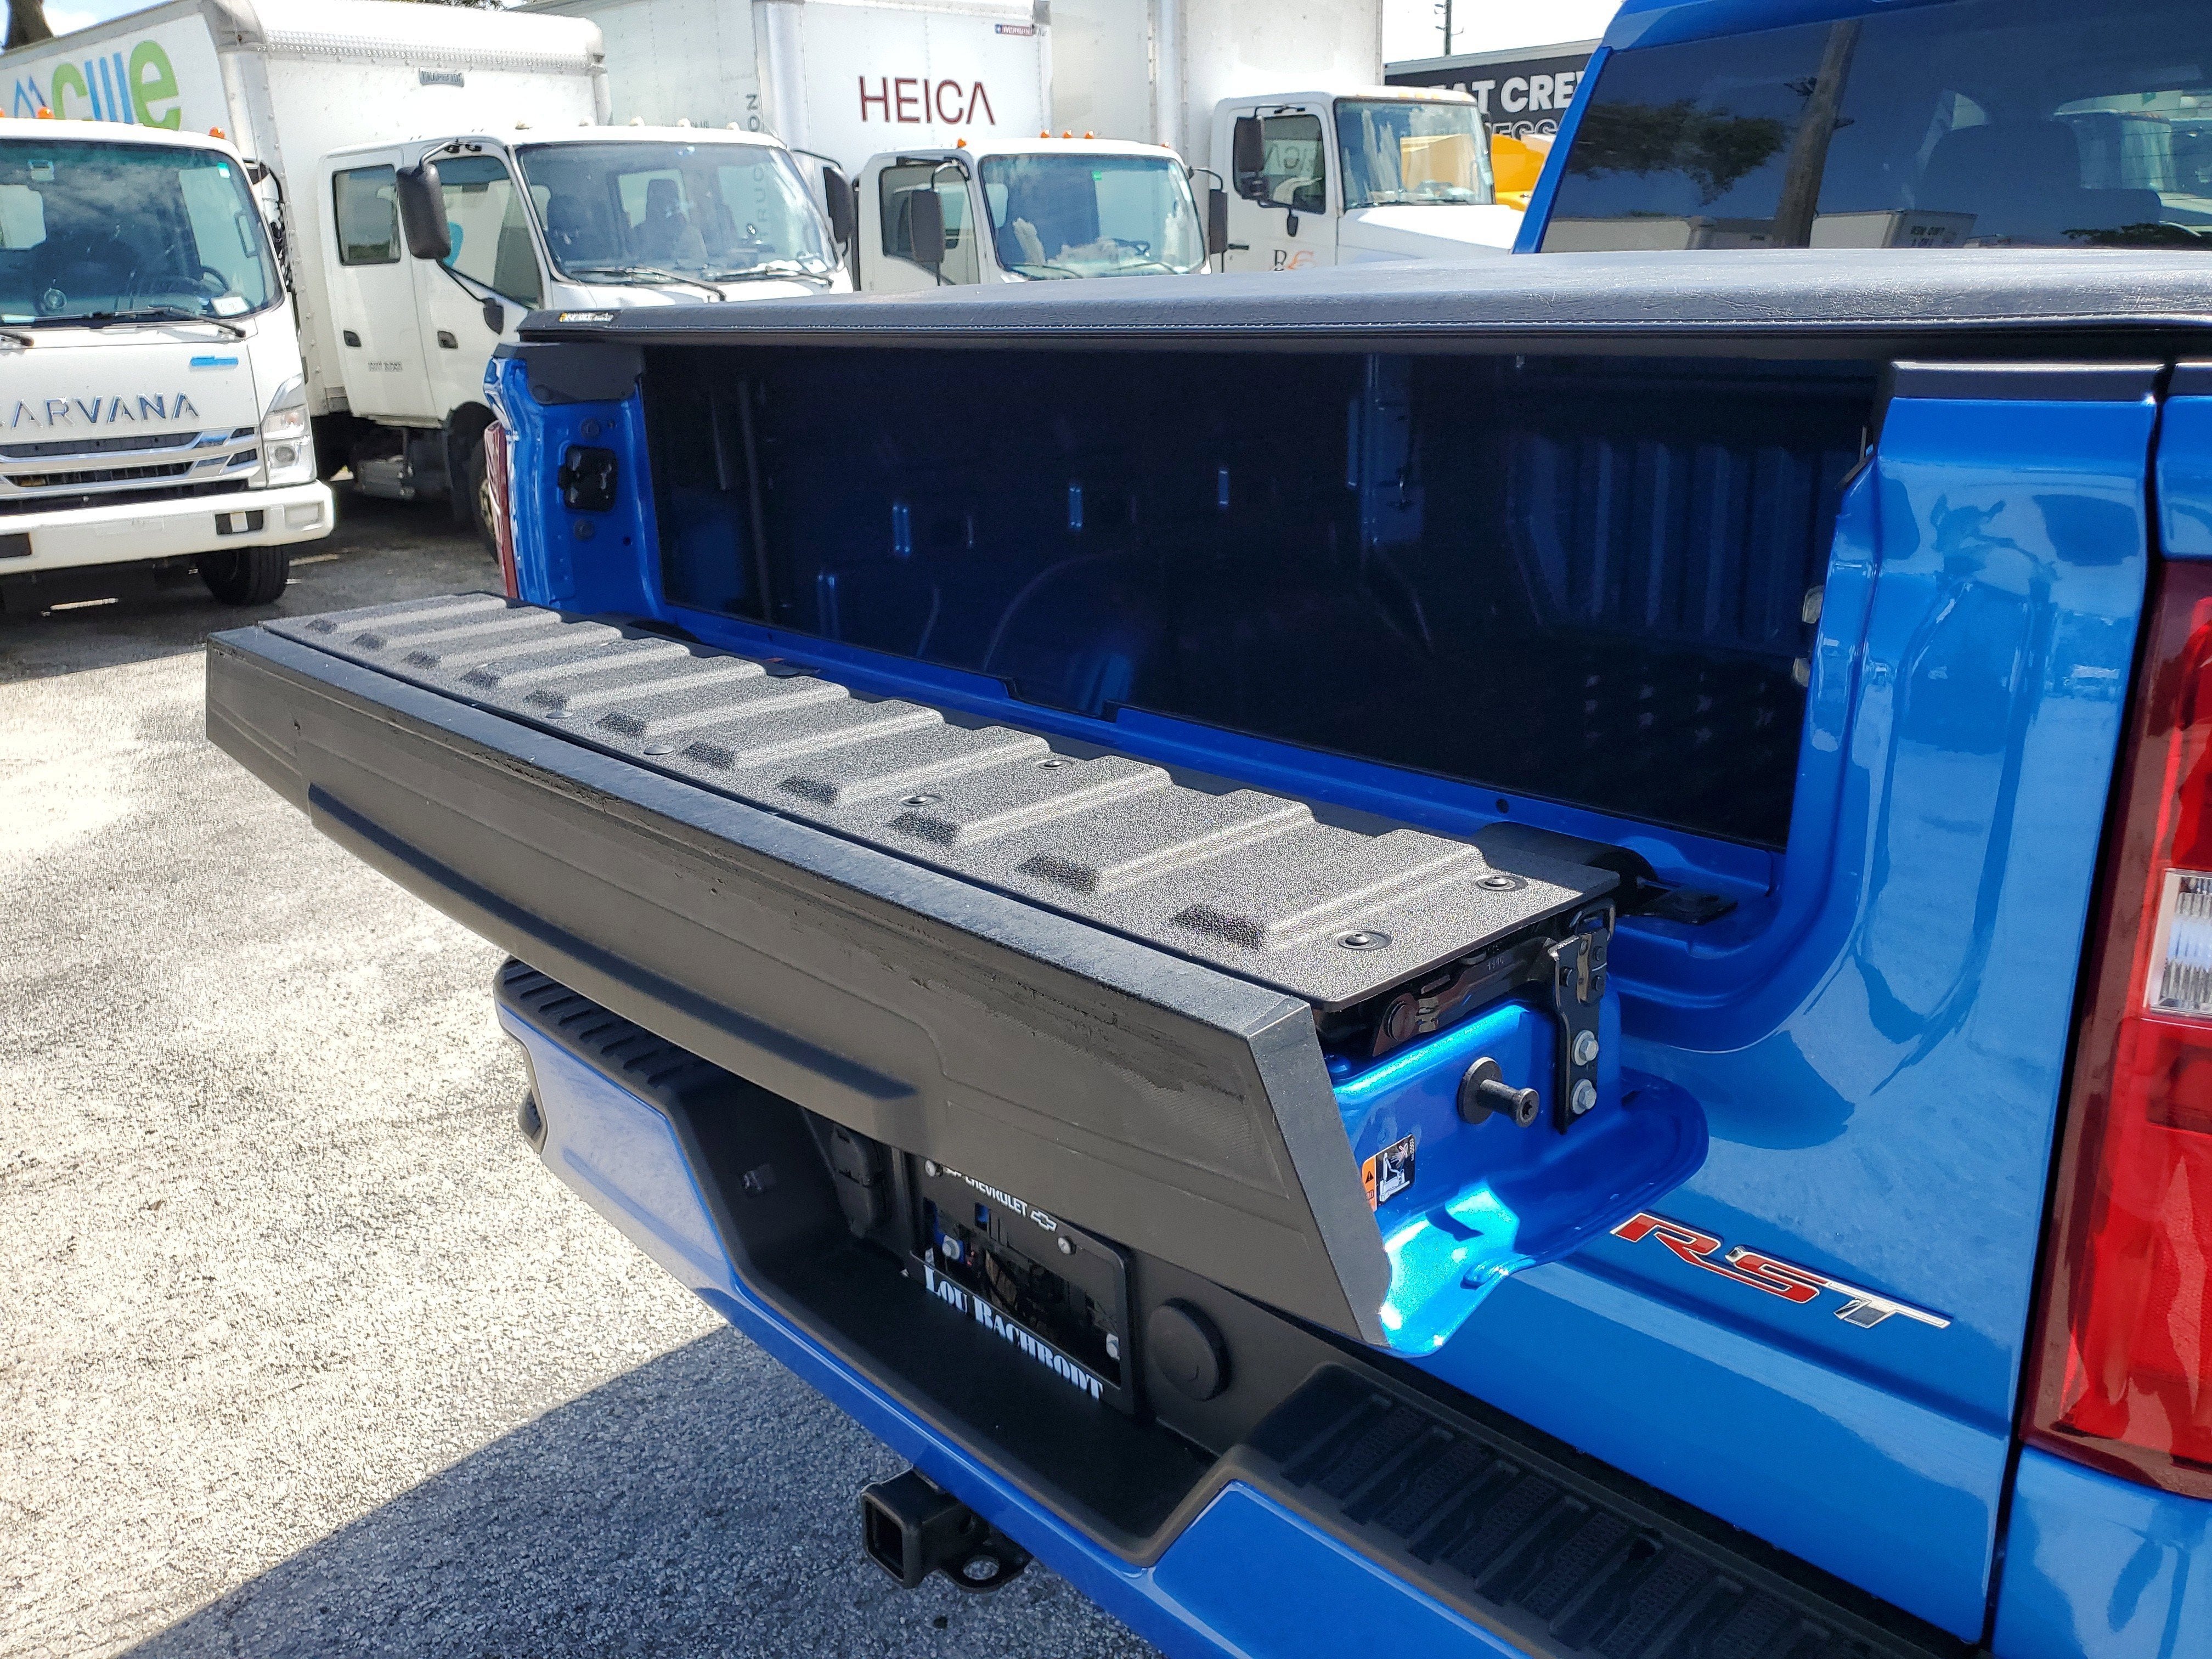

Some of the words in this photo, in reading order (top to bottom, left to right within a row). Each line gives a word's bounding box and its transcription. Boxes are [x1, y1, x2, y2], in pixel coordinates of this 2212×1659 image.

[857, 75, 996, 126] HEICA
[1500, 71, 1585, 113] CRE
[0, 390, 201, 430] ARVANA
[923, 1264, 968, 1316] LOU
[1609, 1212, 1952, 1329] RST
